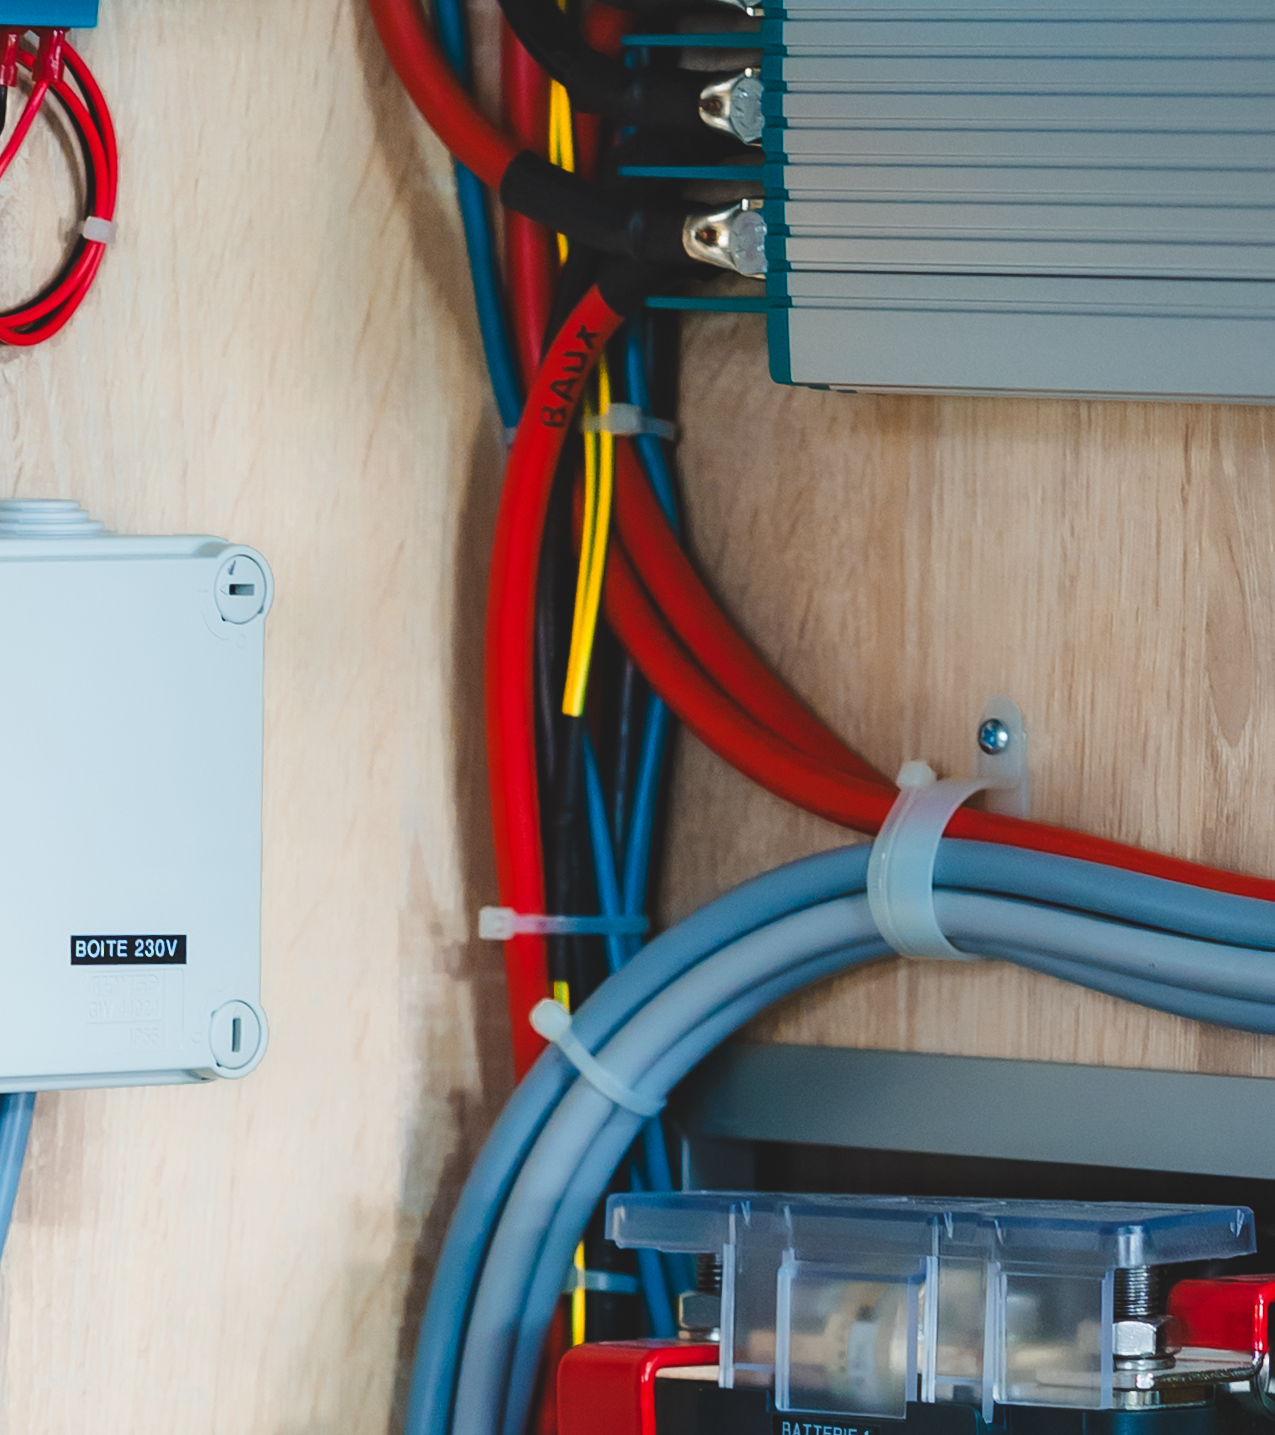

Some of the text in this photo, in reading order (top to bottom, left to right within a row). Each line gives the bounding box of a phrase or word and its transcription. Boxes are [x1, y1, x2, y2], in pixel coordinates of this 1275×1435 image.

[540, 324, 596, 427] BAUX
[76, 938, 178, 958] BOITE 230V
